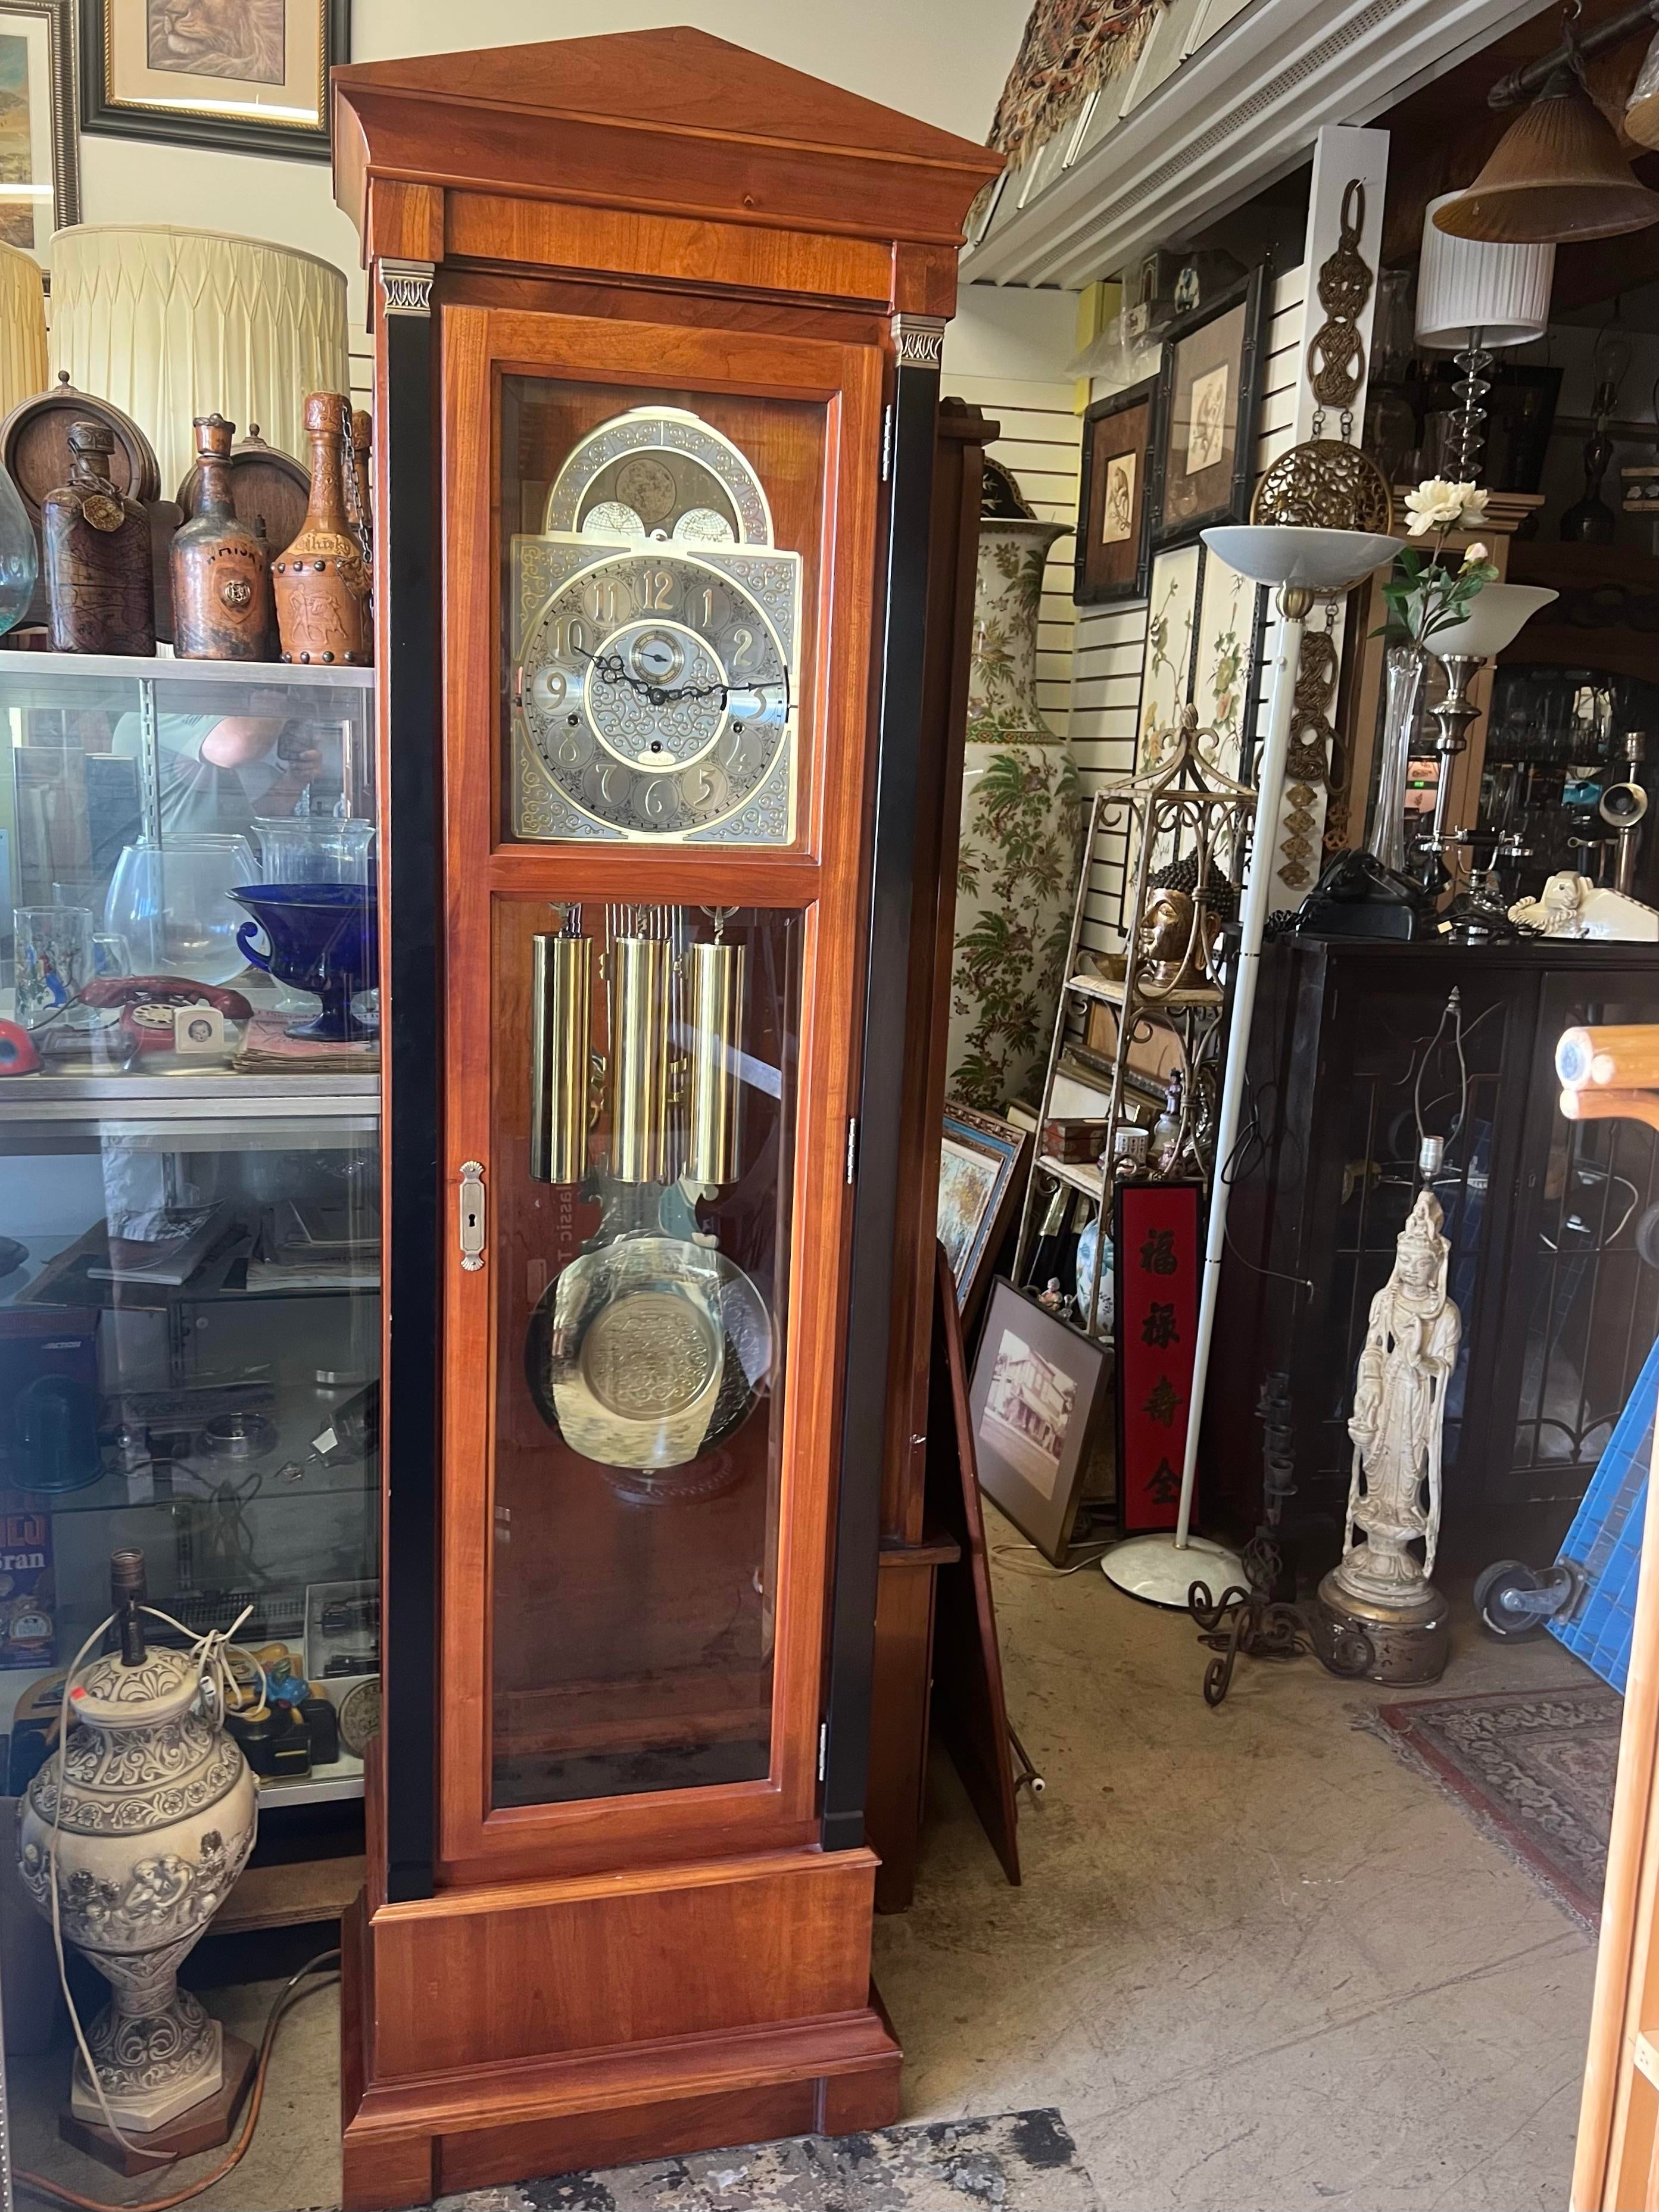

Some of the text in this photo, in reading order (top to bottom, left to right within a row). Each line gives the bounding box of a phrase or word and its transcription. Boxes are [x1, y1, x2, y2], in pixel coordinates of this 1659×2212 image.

[594, 582, 619, 622] 11
[643, 570, 675, 610] 12
[702, 588, 713, 628] 1
[554, 618, 583, 658] 10
[733, 628, 754, 667] 2
[547, 672, 567, 710] 9
[744, 684, 767, 720] 3
[559, 727, 581, 764] 8
[726, 734, 751, 772] 4
[596, 764, 618, 803] 7
[645, 779, 663, 817] 6
[693, 768, 716, 807] 5
